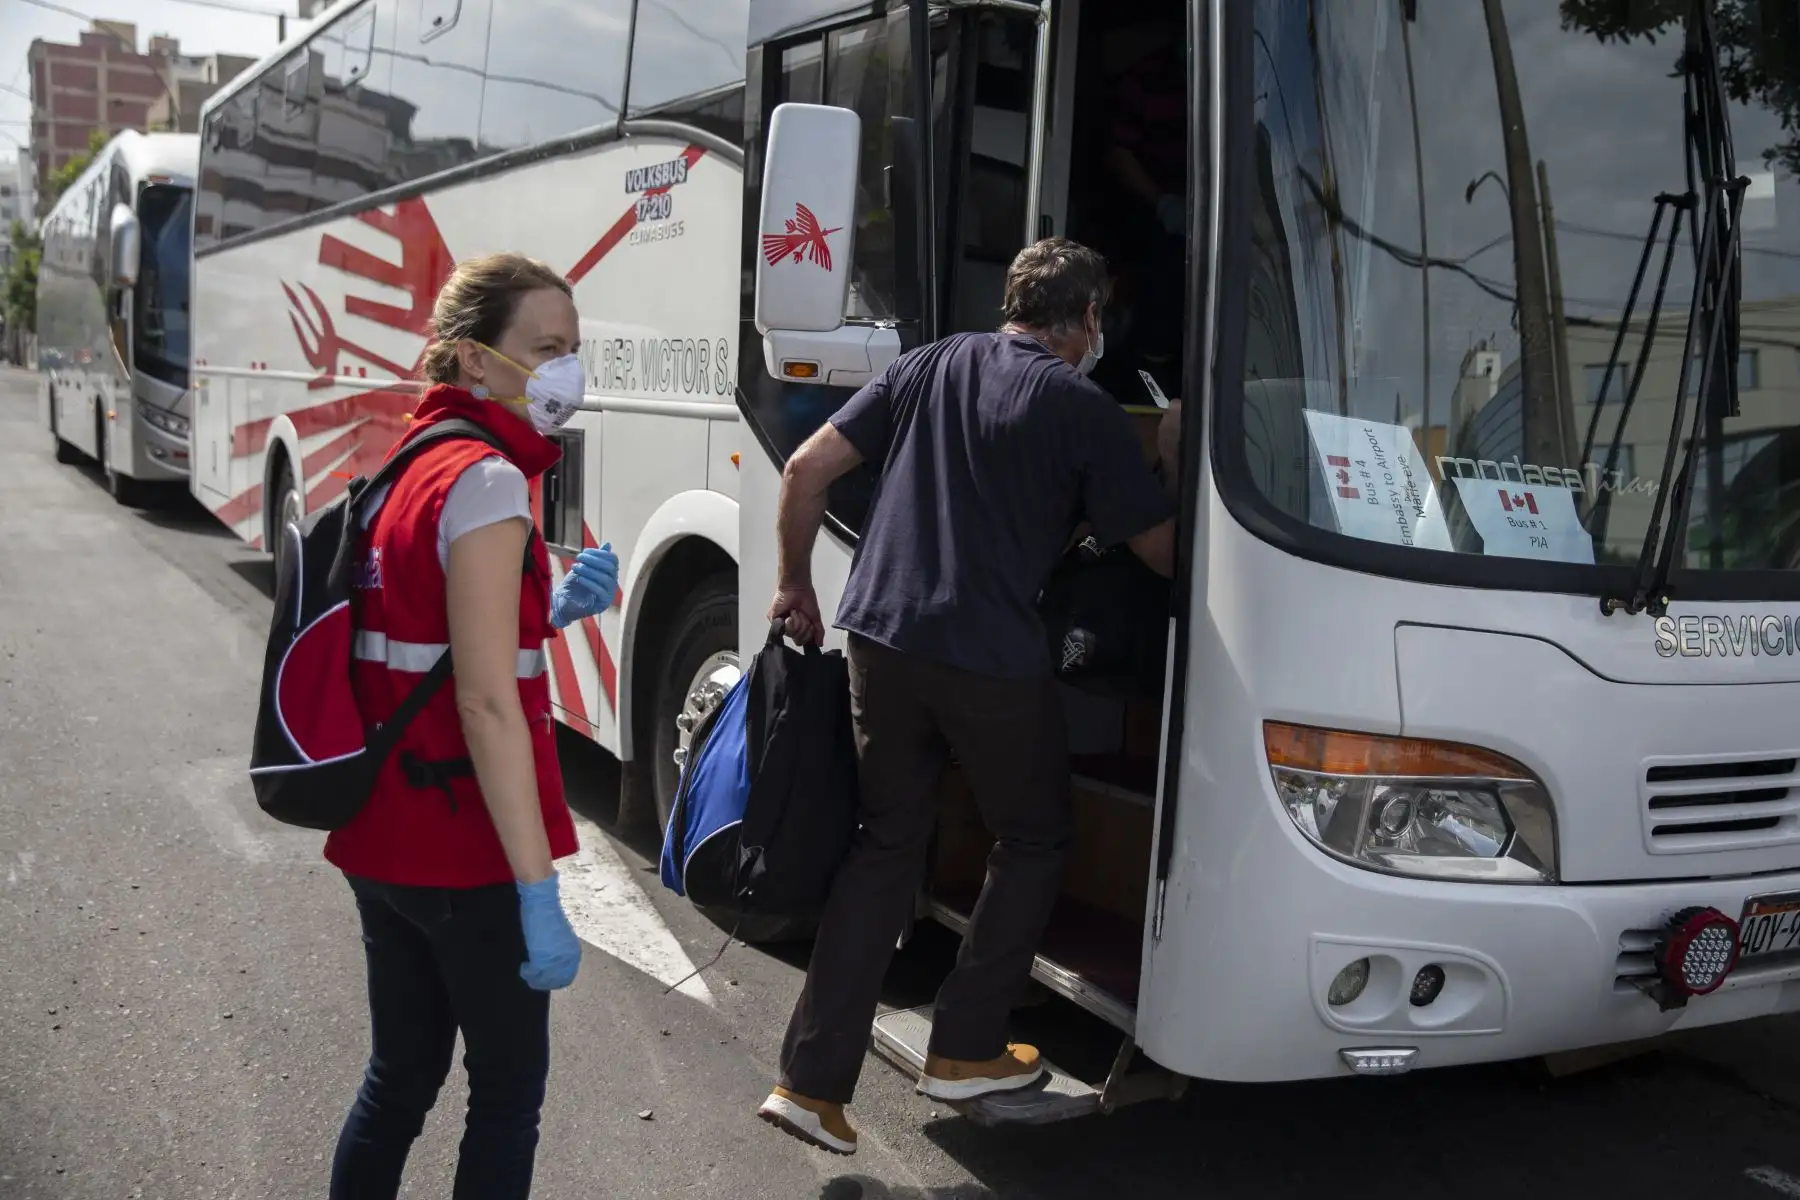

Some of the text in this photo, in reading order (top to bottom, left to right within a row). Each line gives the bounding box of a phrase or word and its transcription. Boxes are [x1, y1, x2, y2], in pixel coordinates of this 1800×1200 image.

[625, 157, 688, 194] VOLKSBUS
[640, 338, 711, 396] VICTOR
[714, 338, 739, 396] S.
[1355, 460, 1366, 468] 4
[1364, 427, 1389, 470] Airport
[1384, 473, 1395, 486] to
[1435, 455, 1586, 493] modasa
[1365, 482, 1379, 505] Bus
[1388, 489, 1414, 546] Embassy
[1507, 516, 1529, 529] Bus
[1529, 536, 1549, 549] PIA
[1654, 615, 1800, 657] SERVICI
